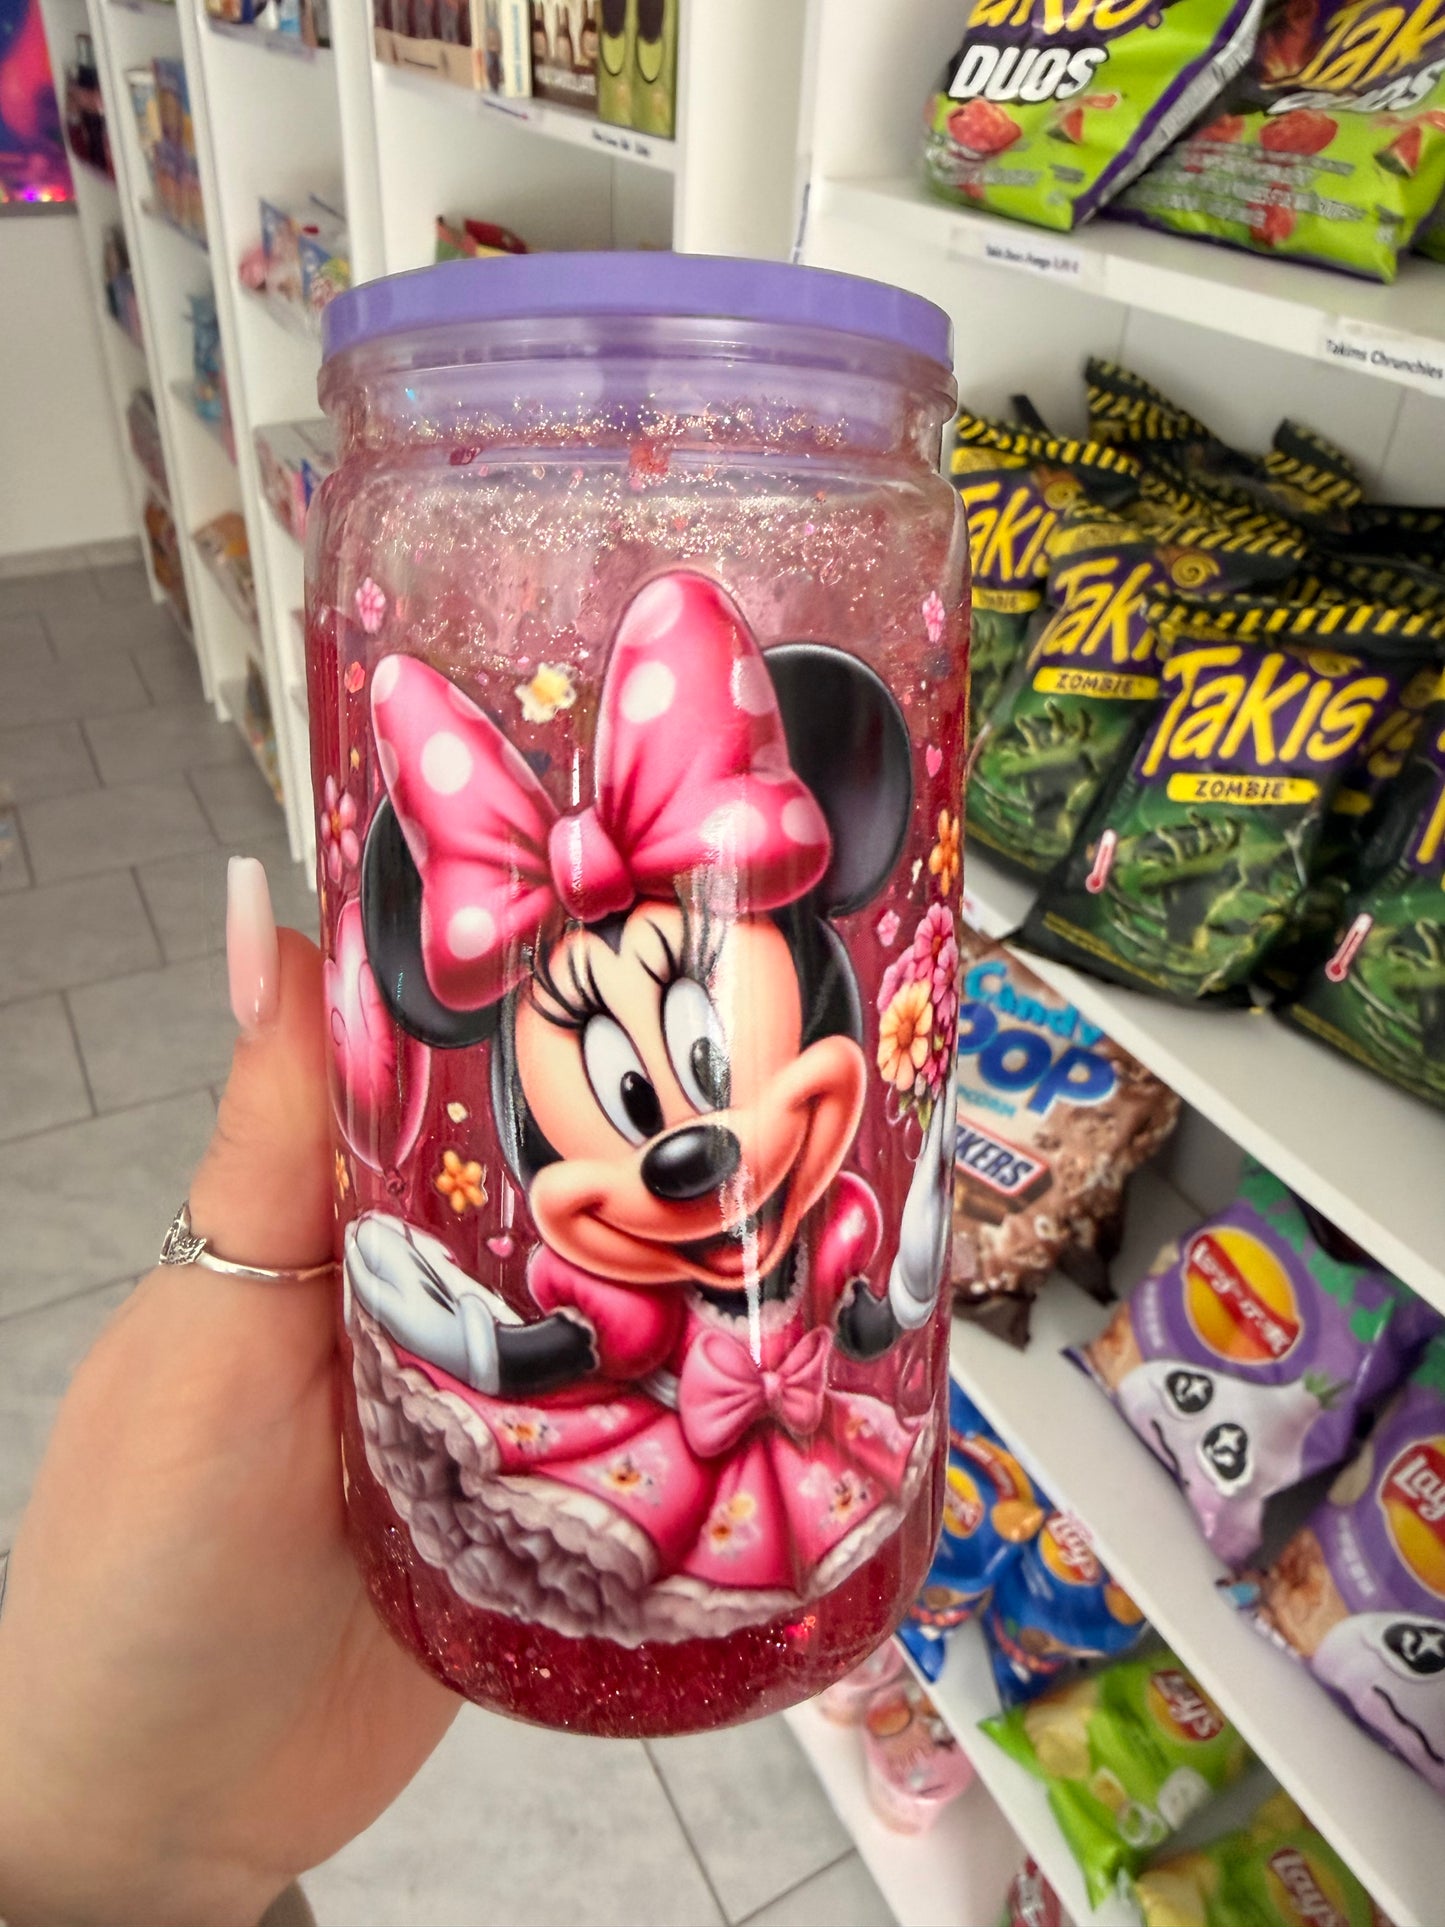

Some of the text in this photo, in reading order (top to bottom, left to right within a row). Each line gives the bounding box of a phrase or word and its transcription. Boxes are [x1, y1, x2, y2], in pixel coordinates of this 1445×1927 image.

[948, 44, 1108, 102] DUOS
[1056, 672, 1134, 696] ZOMBIE
[1141, 645, 1389, 777] Takis
[1194, 780, 1285, 800] ZOMBIE
[955, 1126, 1034, 1187] KERS
